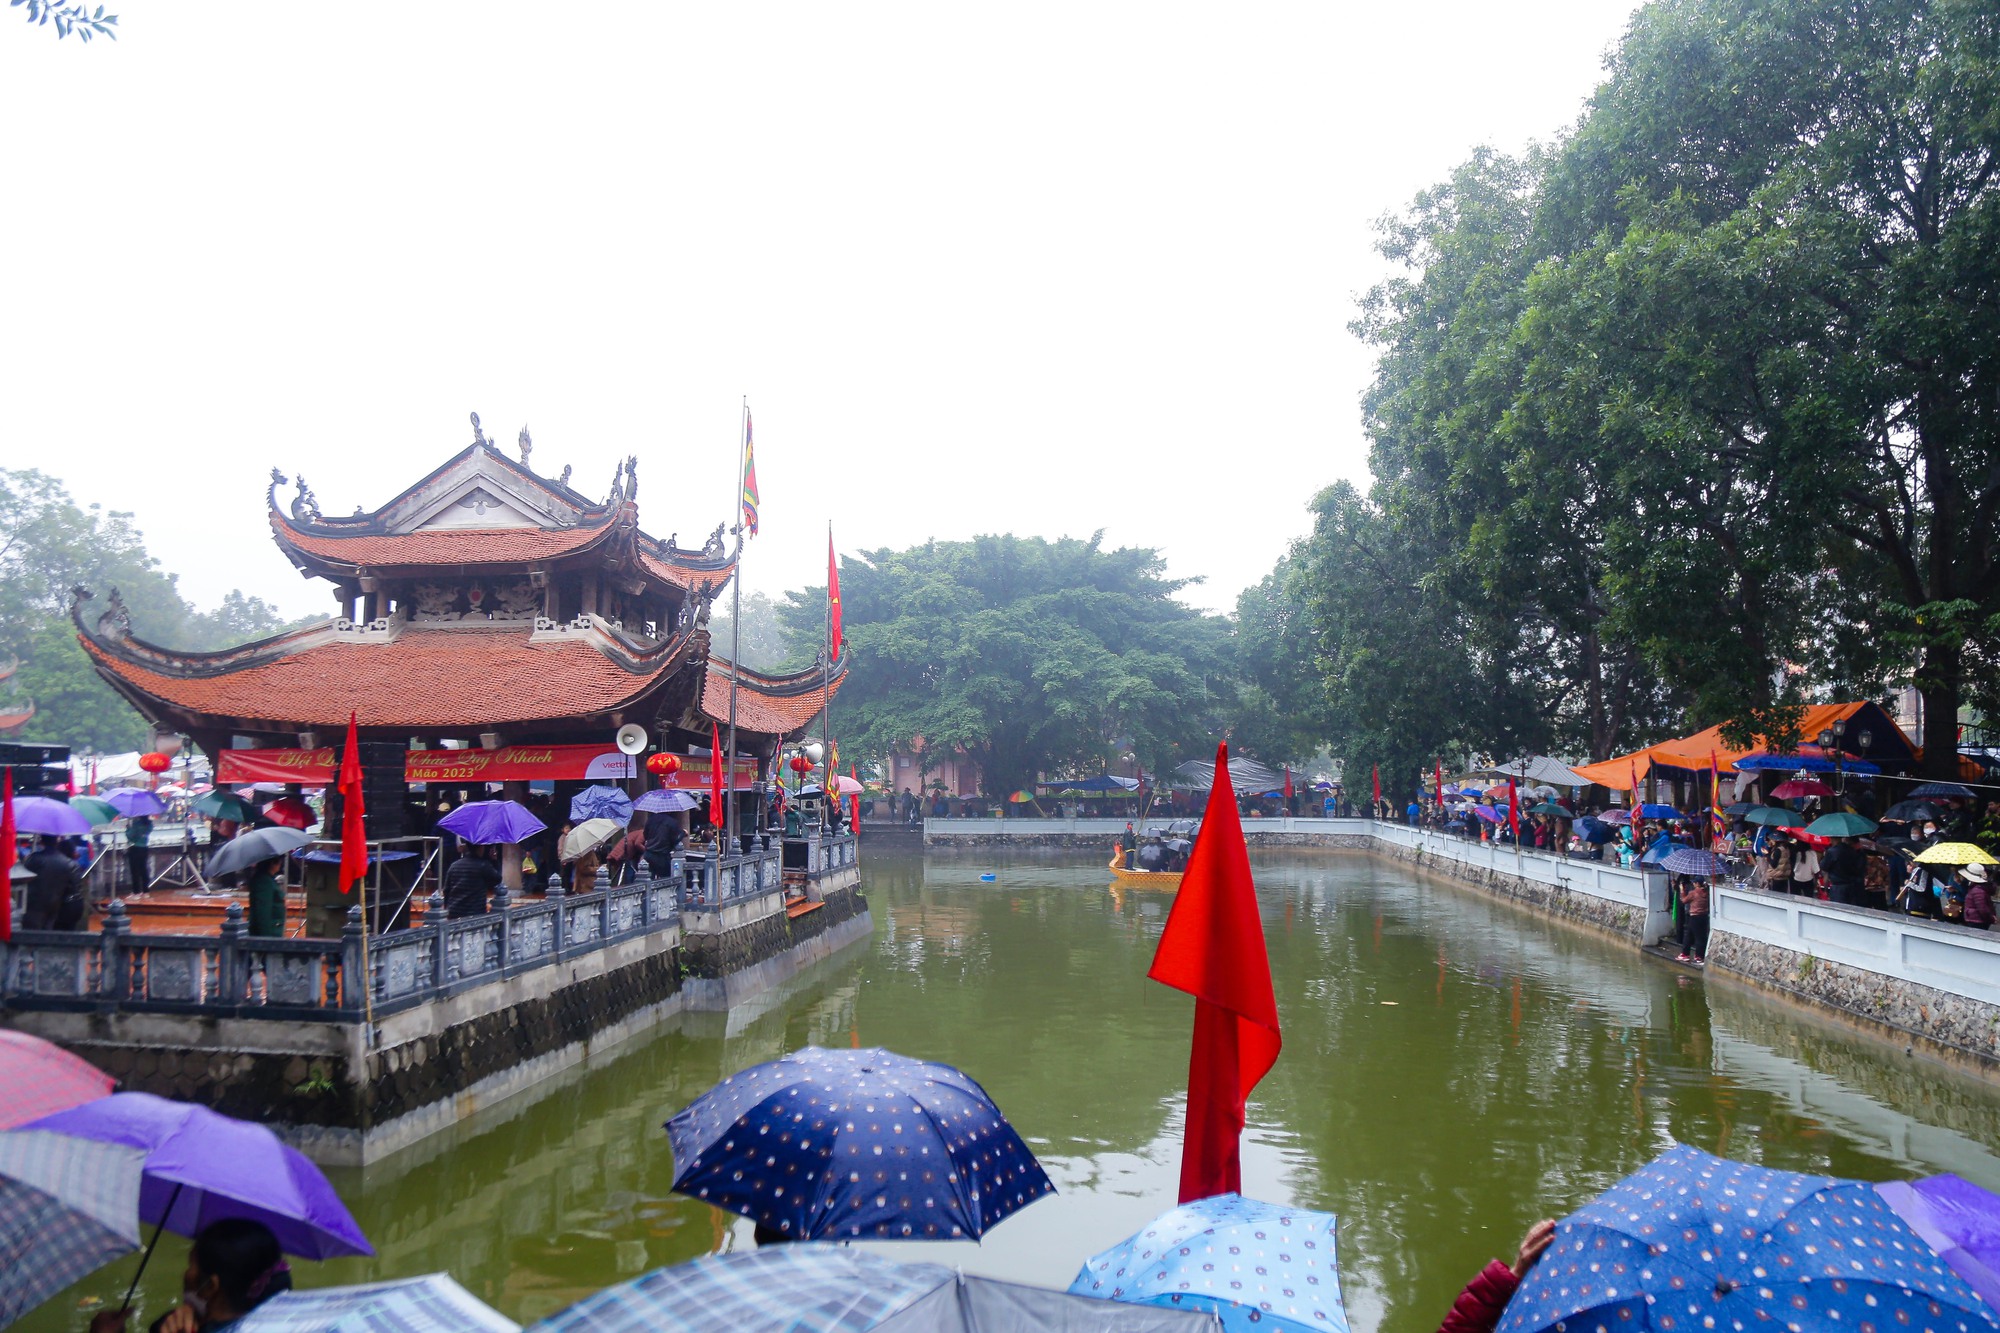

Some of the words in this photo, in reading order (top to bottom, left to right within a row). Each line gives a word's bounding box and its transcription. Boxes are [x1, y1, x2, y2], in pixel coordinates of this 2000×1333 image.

[456, 750, 493, 770] Quý
[495, 748, 553, 764] Khách
[412, 768, 438, 778] Mão
[442, 767, 475, 778] 2023
